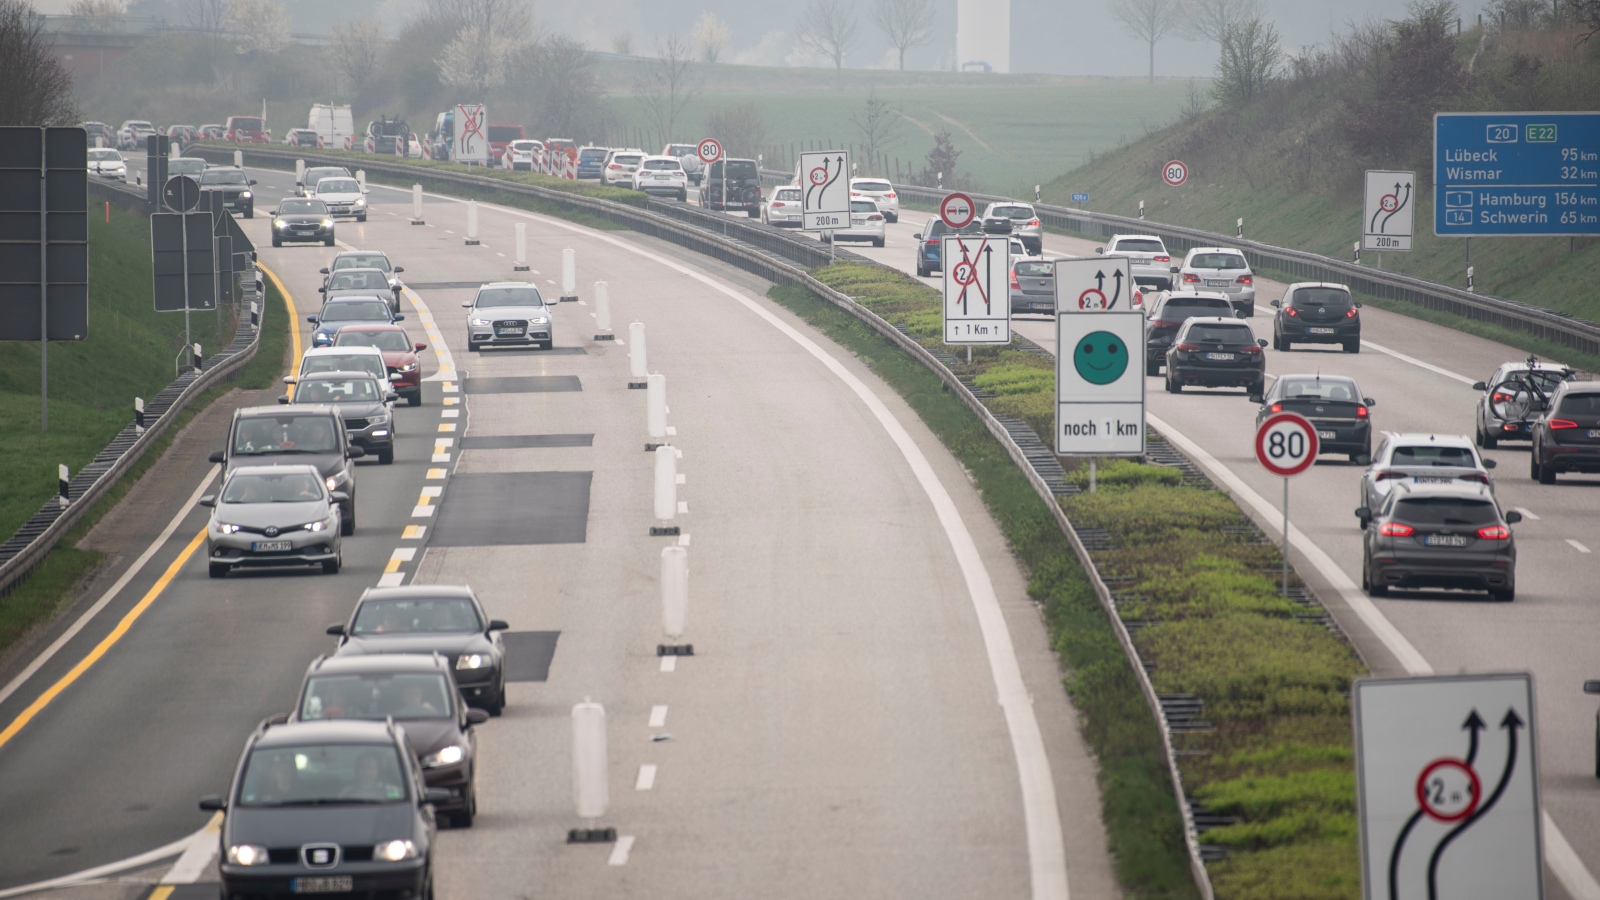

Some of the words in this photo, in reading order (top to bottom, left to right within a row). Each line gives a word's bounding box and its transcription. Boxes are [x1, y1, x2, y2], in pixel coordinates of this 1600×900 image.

[1495, 128, 1510, 140] 20
[703, 145, 716, 155] 80
[1445, 149, 1498, 162] Lübeck
[1561, 148, 1578, 161] 95
[1580, 151, 1598, 161] km
[1168, 168, 1181, 179] 80
[1446, 167, 1503, 180] Wismar
[1560, 166, 1578, 179] 32
[1580, 169, 1598, 179] km
[1457, 194, 1462, 204] 1
[1479, 193, 1546, 208] Hamburg
[1555, 192, 1577, 205] 156
[1580, 195, 1597, 205] km
[816, 216, 830, 226] 200
[831, 217, 839, 225] m
[1453, 213, 1464, 222] 14
[1480, 211, 1548, 224] Schwerin
[1560, 211, 1577, 224] 65
[1580, 214, 1597, 224] km
[1376, 237, 1391, 247] 200
[959, 267, 966, 281] 2
[1085, 297, 1091, 308] 2
[967, 324, 970, 335] 1
[975, 324, 988, 335] Km
[1064, 420, 1096, 436] noch
[1105, 423, 1111, 435] 1
[1117, 420, 1137, 436] km
[1269, 431, 1304, 459] 80
[1431, 778, 1443, 804] 2
